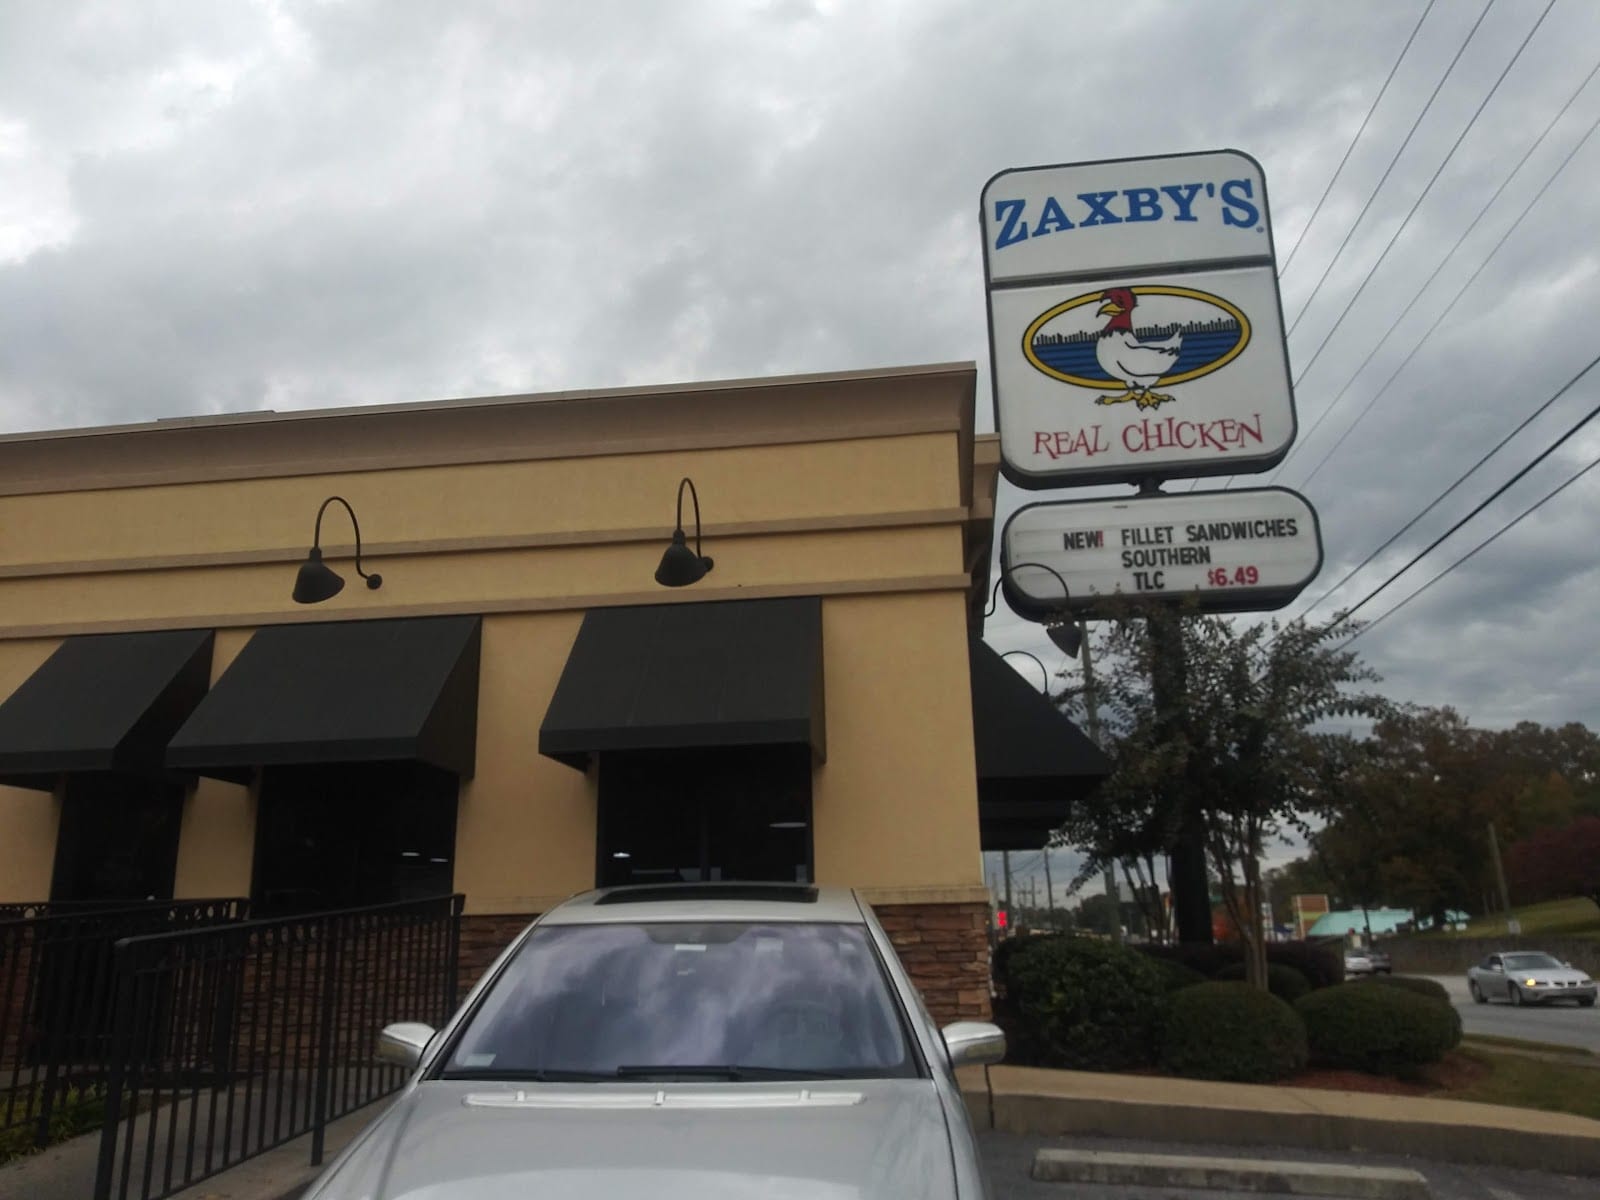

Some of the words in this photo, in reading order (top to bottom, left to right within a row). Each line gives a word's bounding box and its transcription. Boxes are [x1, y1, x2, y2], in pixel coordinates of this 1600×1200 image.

[995, 178, 1261, 250] ZAXBY'S
[1033, 424, 1110, 460] REAL
[1121, 413, 1265, 453] CHICKEN
[1063, 530, 1104, 550] NEW!
[1121, 526, 1174, 546] FILLET
[1186, 519, 1298, 543] SANDWICHES
[1121, 547, 1211, 569] SOUTHERN
[1133, 570, 1165, 591] TLC
[1207, 566, 1259, 586] $6.49
